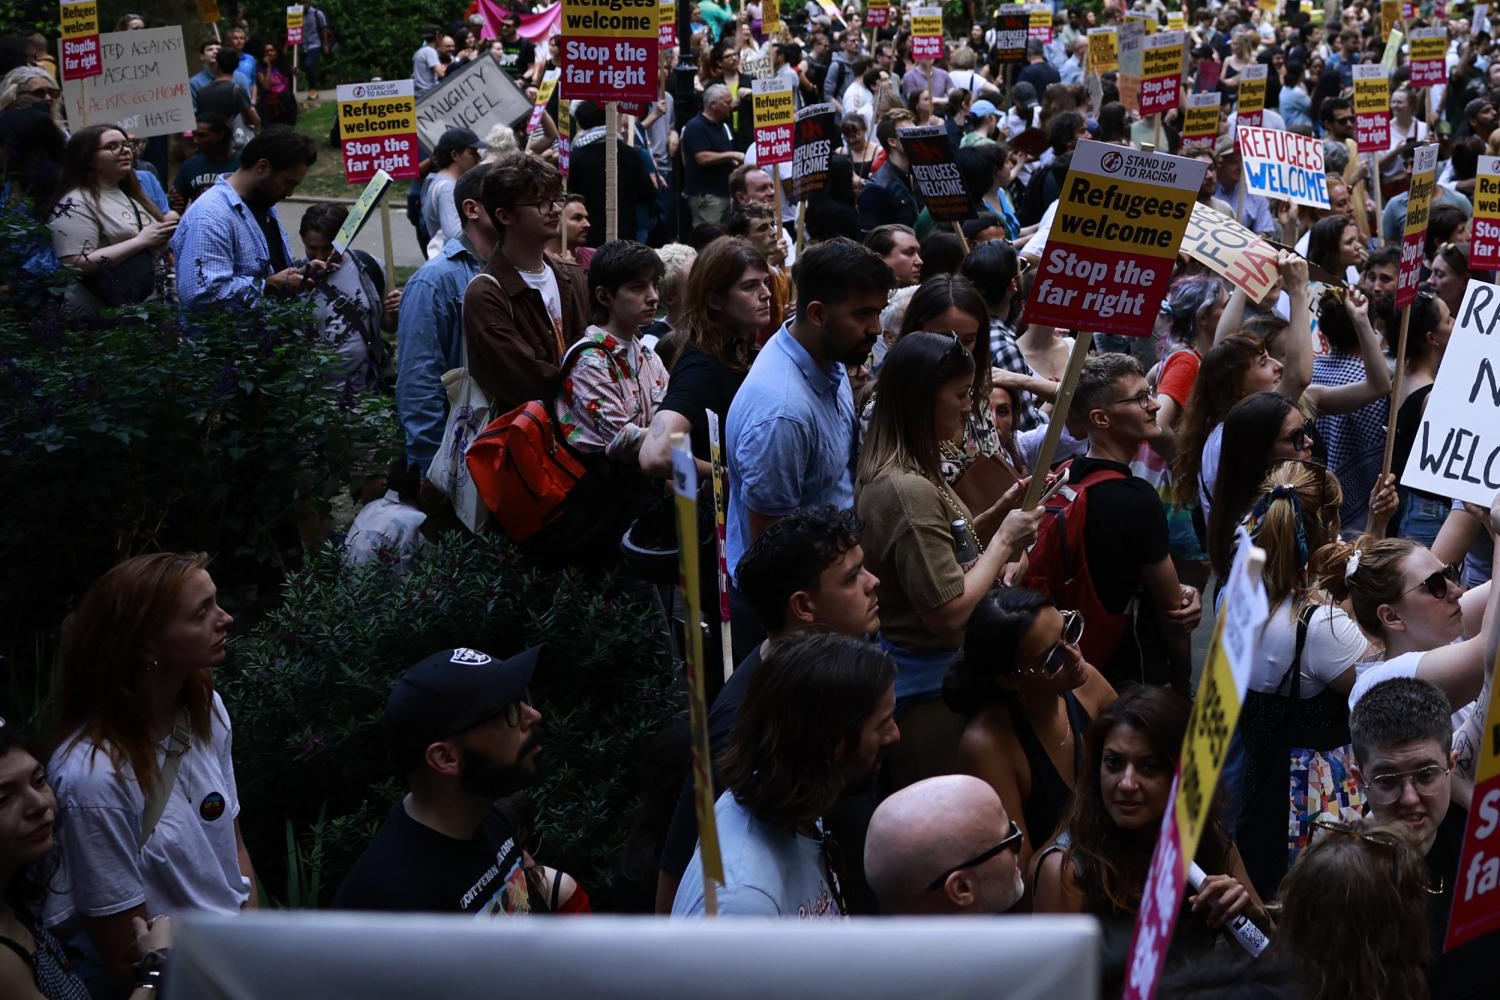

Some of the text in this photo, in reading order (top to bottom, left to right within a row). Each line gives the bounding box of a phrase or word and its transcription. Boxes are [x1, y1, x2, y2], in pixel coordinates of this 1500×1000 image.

[63, 6, 96, 20] Refugees
[567, 12, 651, 30] welcome
[131, 37, 183, 57] AGAINST
[566, 41, 648, 66] Stop the
[1144, 49, 1181, 63] Refugees
[1144, 61, 1179, 74] welcome
[565, 67, 646, 90] far right
[1142, 78, 1176, 94] Stop the
[1142, 91, 1175, 105] far right
[1356, 82, 1387, 96] Refugees
[416, 66, 486, 131] NAUGHTY
[755, 96, 792, 110] Refugees
[1356, 97, 1387, 108] welcome
[145, 109, 182, 128] HATE
[343, 102, 412, 118] Refugees
[756, 110, 790, 123] welcome
[344, 118, 410, 133] welcome
[1356, 114, 1388, 129] Stop the
[756, 128, 791, 144] Stop the
[1357, 130, 1388, 144] far right
[345, 138, 409, 157] Stop the
[758, 142, 791, 157] far right
[794, 140, 831, 161] REFUGEES
[1239, 128, 1323, 171] REFUGEES
[347, 155, 410, 173] far right
[792, 155, 829, 178] WELCOME
[912, 163, 960, 180] REFUGEES
[1125, 154, 1176, 171] STAND UP
[1124, 166, 1178, 184] TO RACISM
[1244, 161, 1330, 203] WELCOME
[919, 179, 968, 198] WELCOME
[1068, 177, 1188, 220] Refugees
[1061, 214, 1173, 248] welcome
[1400, 239, 1418, 263] Stop
[1473, 240, 1495, 257] far
[1046, 248, 1155, 287] Stop the
[1037, 279, 1146, 318] far right
